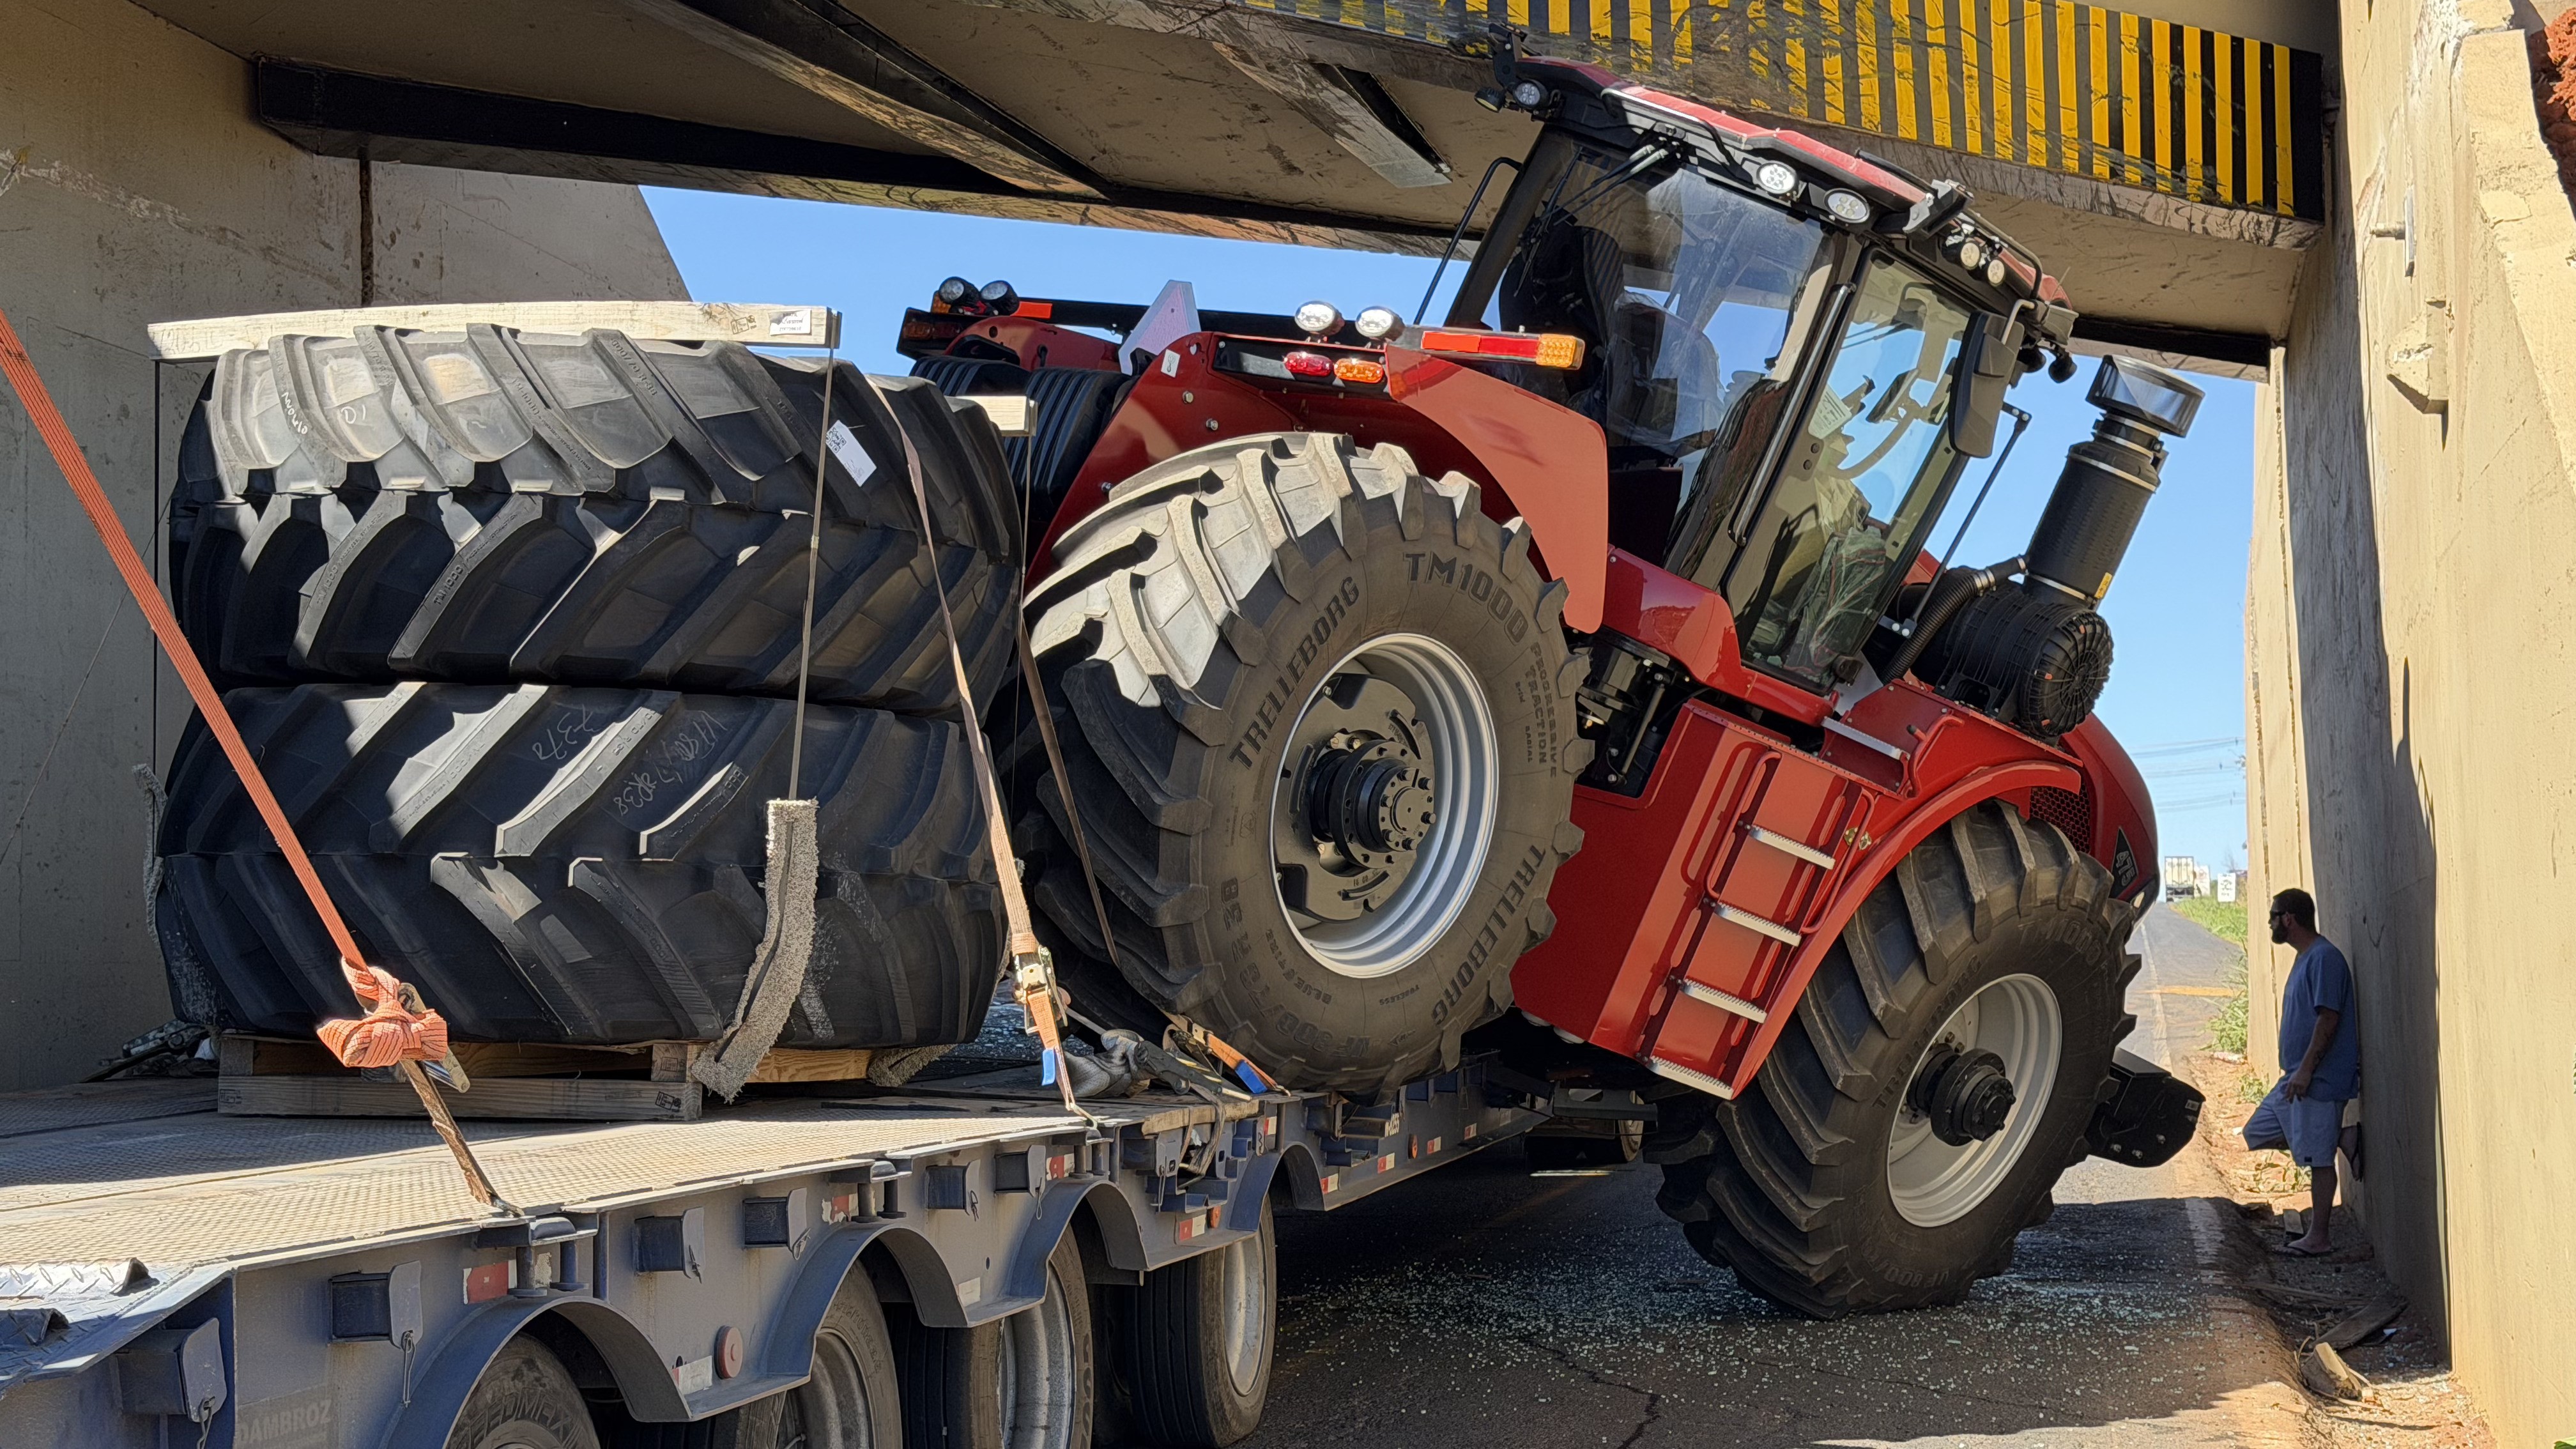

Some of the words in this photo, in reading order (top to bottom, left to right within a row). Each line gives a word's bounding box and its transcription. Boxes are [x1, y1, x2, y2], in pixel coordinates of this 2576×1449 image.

[1404, 551, 1529, 645] TM1000
[1227, 576, 1360, 769] TRELLEBORG
[1526, 663, 1547, 764] TRACTION
[2115, 850, 2135, 887] 475
[1430, 845, 1547, 1025] TRELLEBORG
[1293, 977, 1332, 1005] BLUE
[237, 1399, 332, 1444] DAMBROZ
